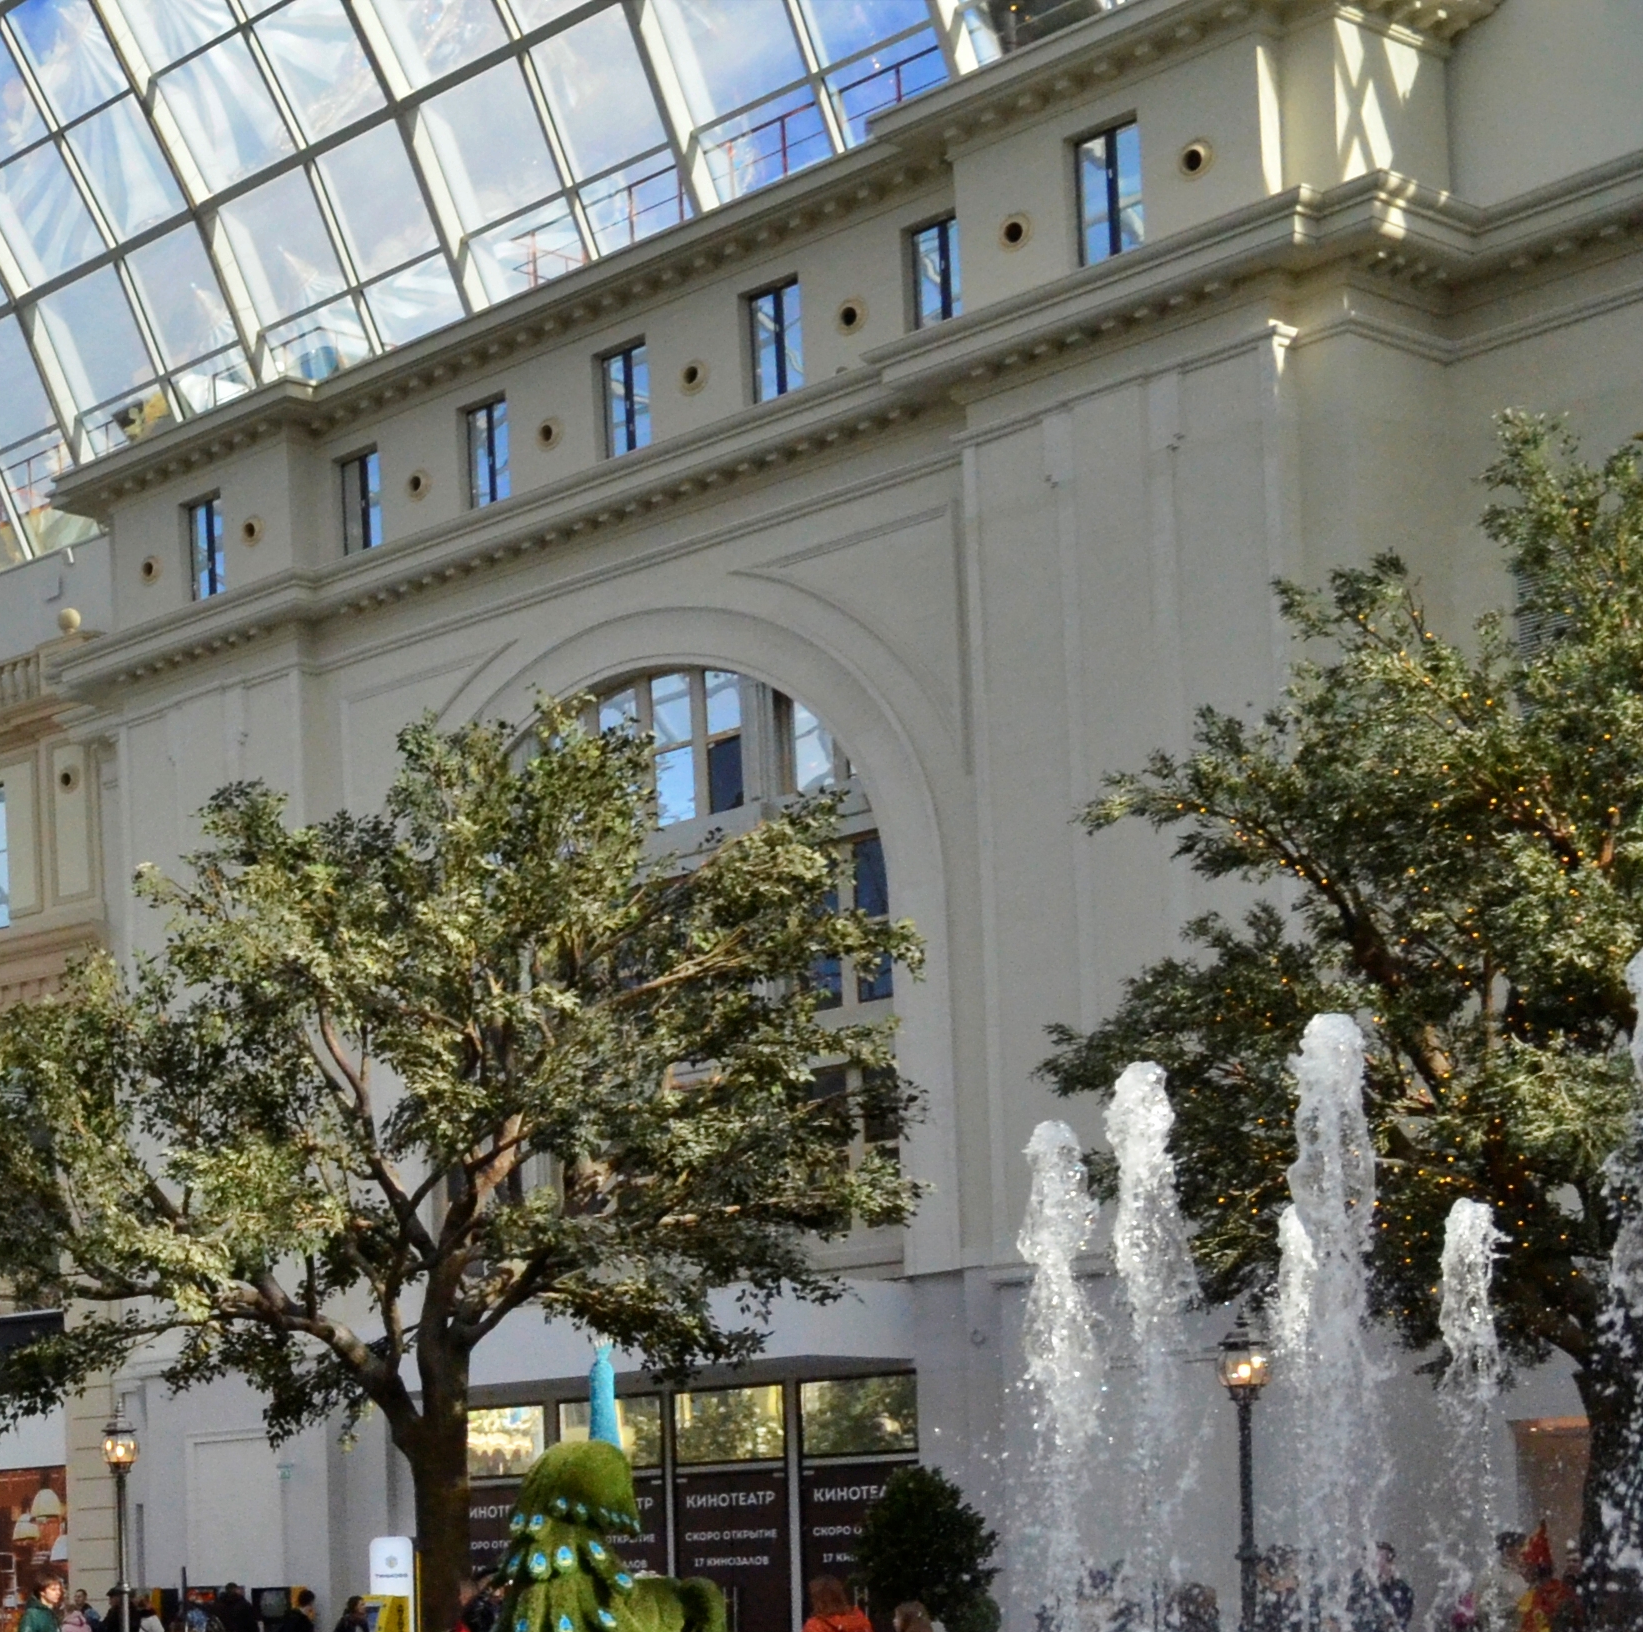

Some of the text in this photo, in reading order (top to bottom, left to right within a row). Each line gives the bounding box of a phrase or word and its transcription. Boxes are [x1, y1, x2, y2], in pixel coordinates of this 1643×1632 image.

[686, 1491, 776, 1508] КИНОТЕАТР
[685, 1528, 777, 1541] СКОРО ОТКРЫТИЕ
[813, 1526, 851, 1537] СКОРО
[694, 1556, 769, 1567] 17 КИНОЗАЛОВ
